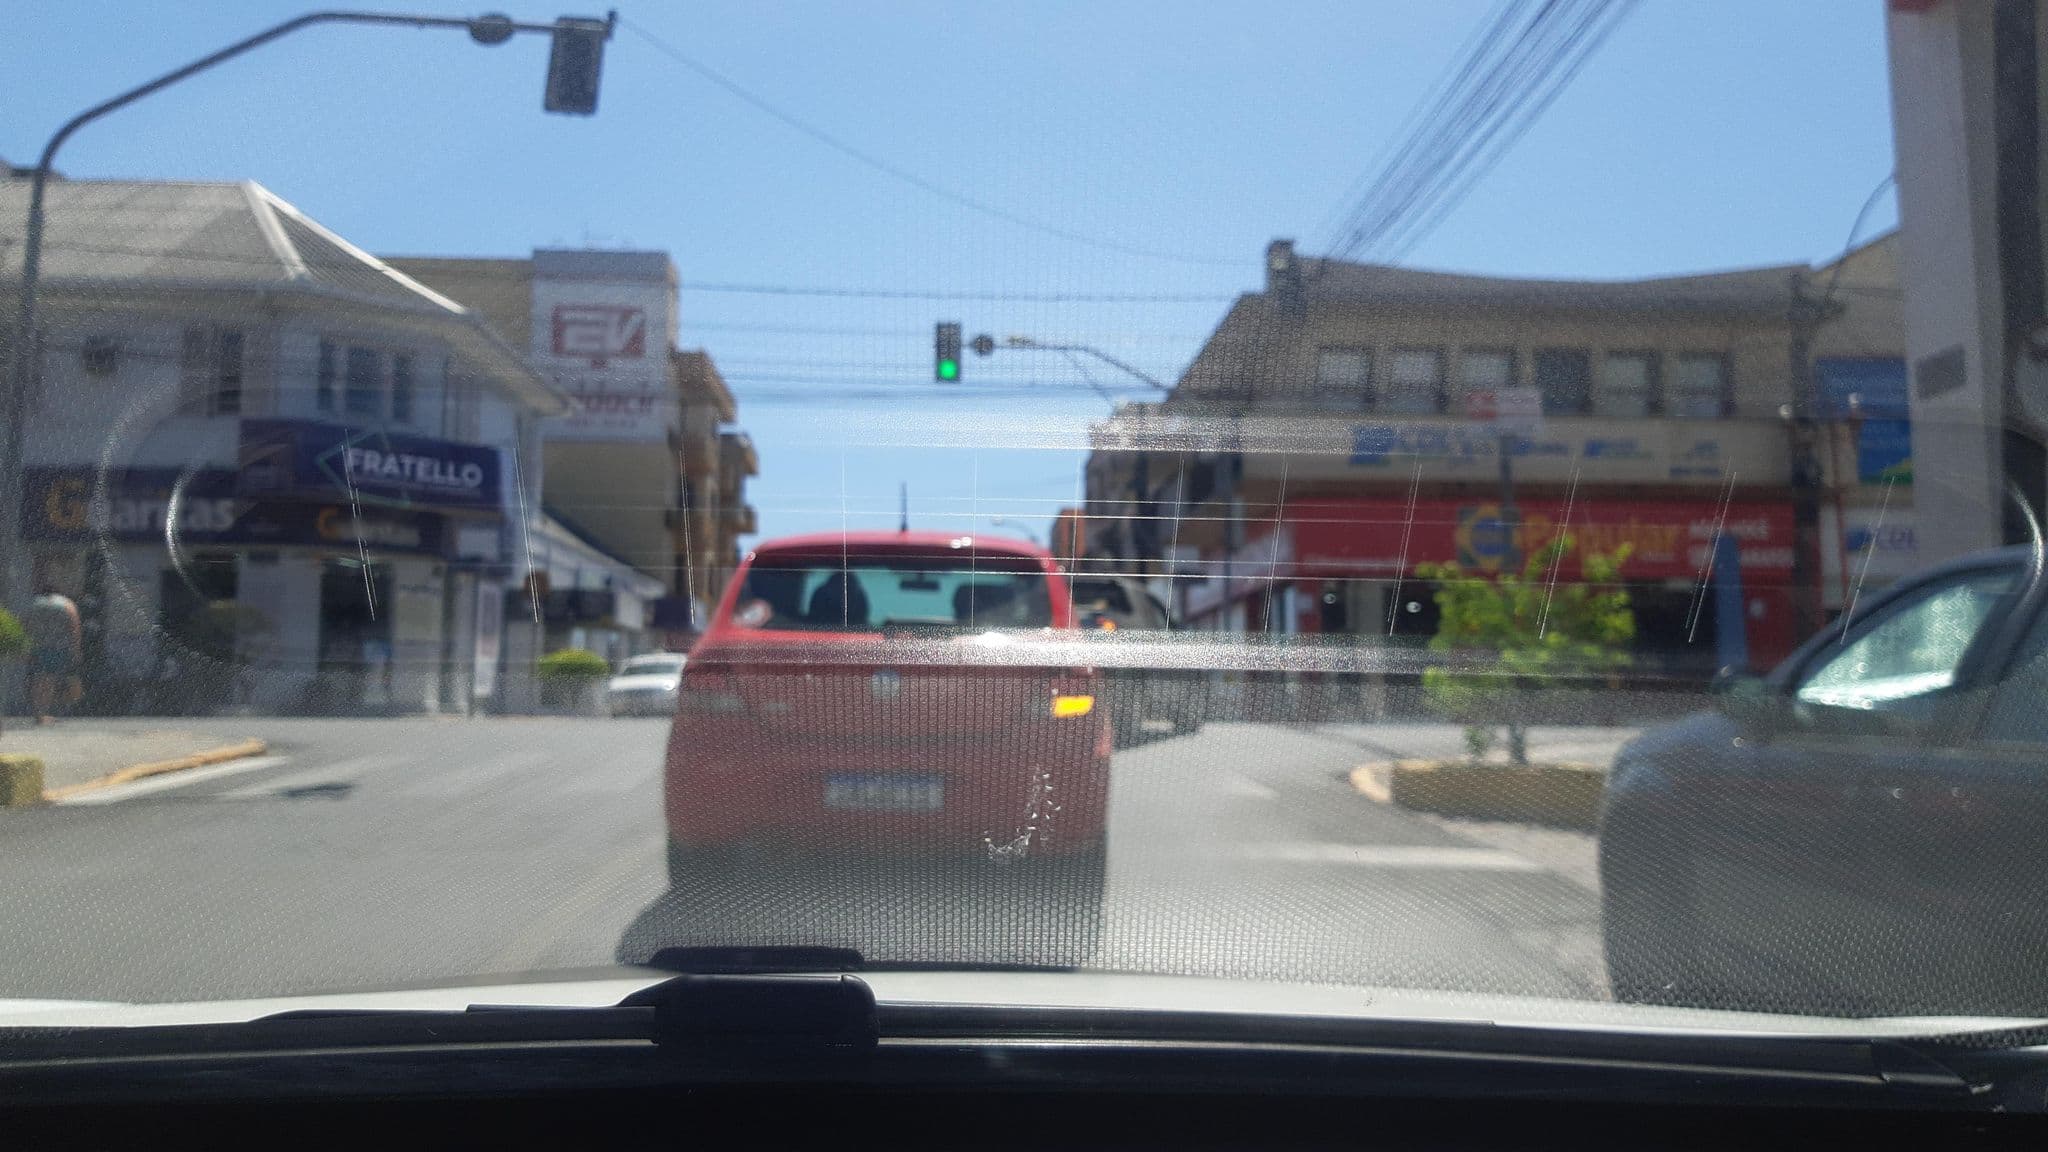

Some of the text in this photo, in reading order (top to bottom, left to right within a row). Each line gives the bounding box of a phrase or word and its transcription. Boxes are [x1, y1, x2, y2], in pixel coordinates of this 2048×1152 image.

[346, 447, 484, 488] FRATELLO
[45, 478, 236, 532] Guarias
[1520, 512, 1681, 562] Ppular
